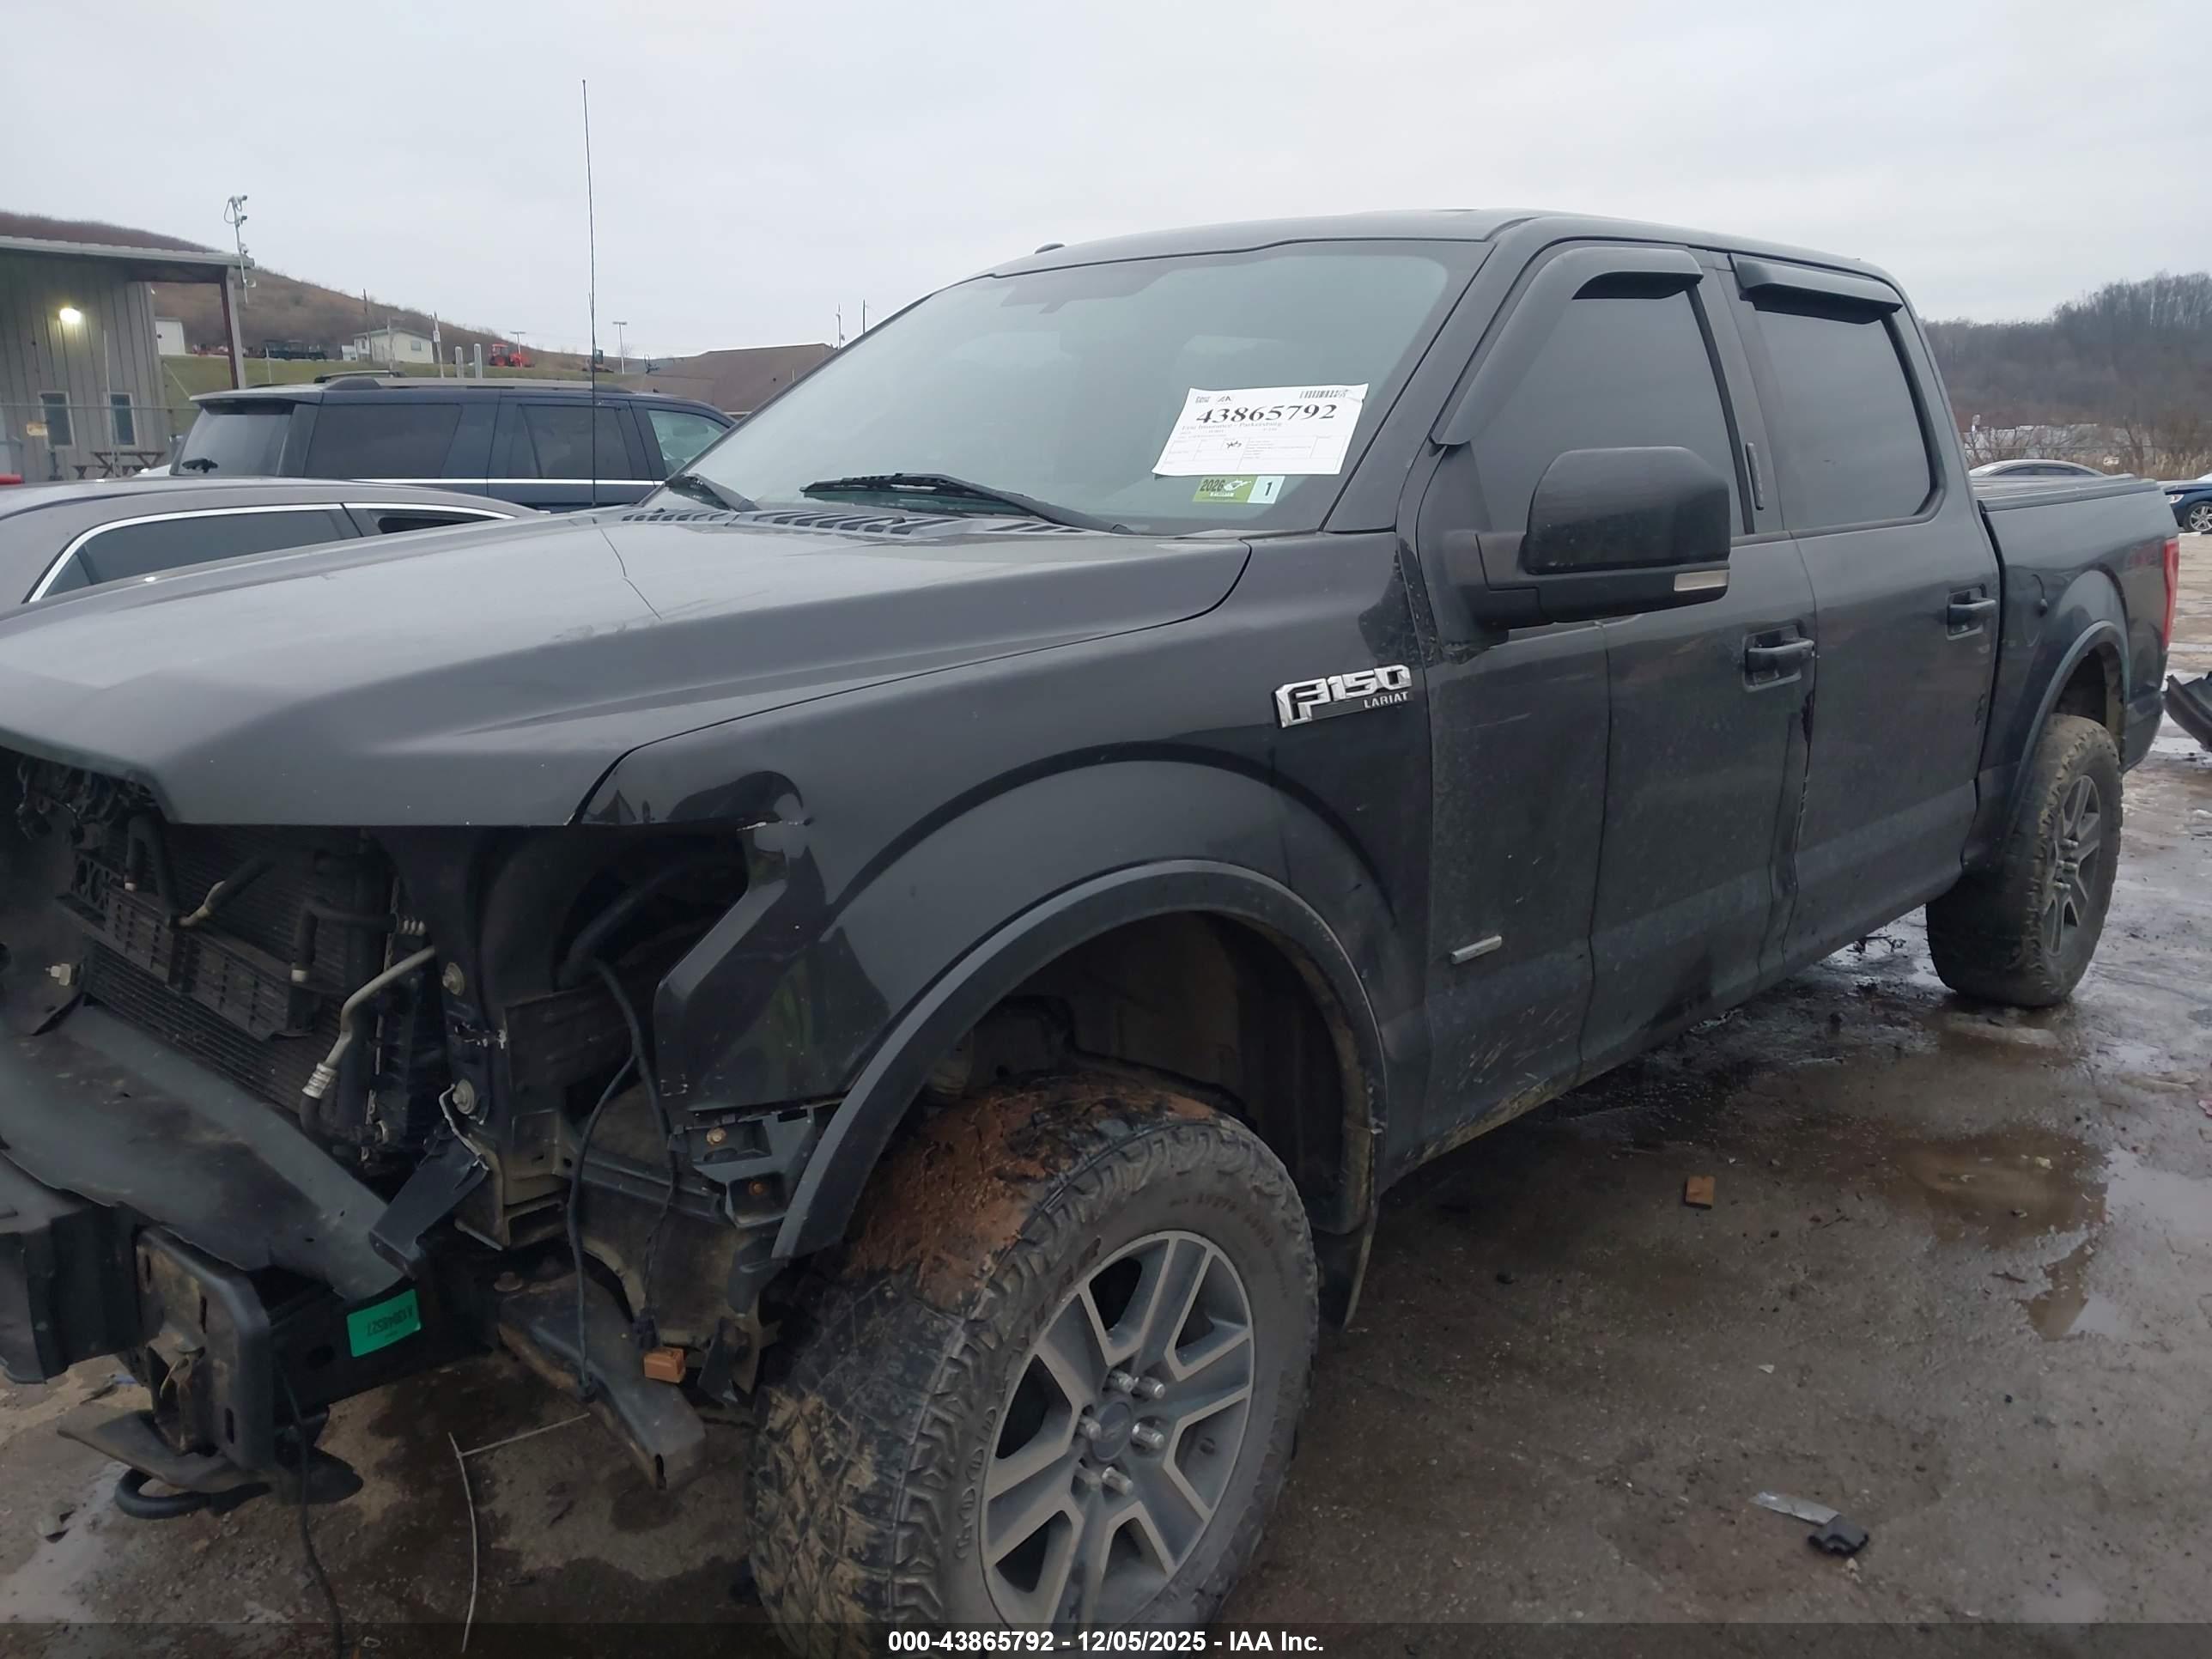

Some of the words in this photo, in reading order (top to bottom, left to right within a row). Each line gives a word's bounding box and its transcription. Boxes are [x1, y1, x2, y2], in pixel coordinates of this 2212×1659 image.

[1196, 404, 1338, 424] 43865792
[1200, 479, 1225, 491] 2026
[1265, 481, 1273, 496] 1
[1275, 665, 1413, 728] F150
[1364, 691, 1409, 708] LARIAT
